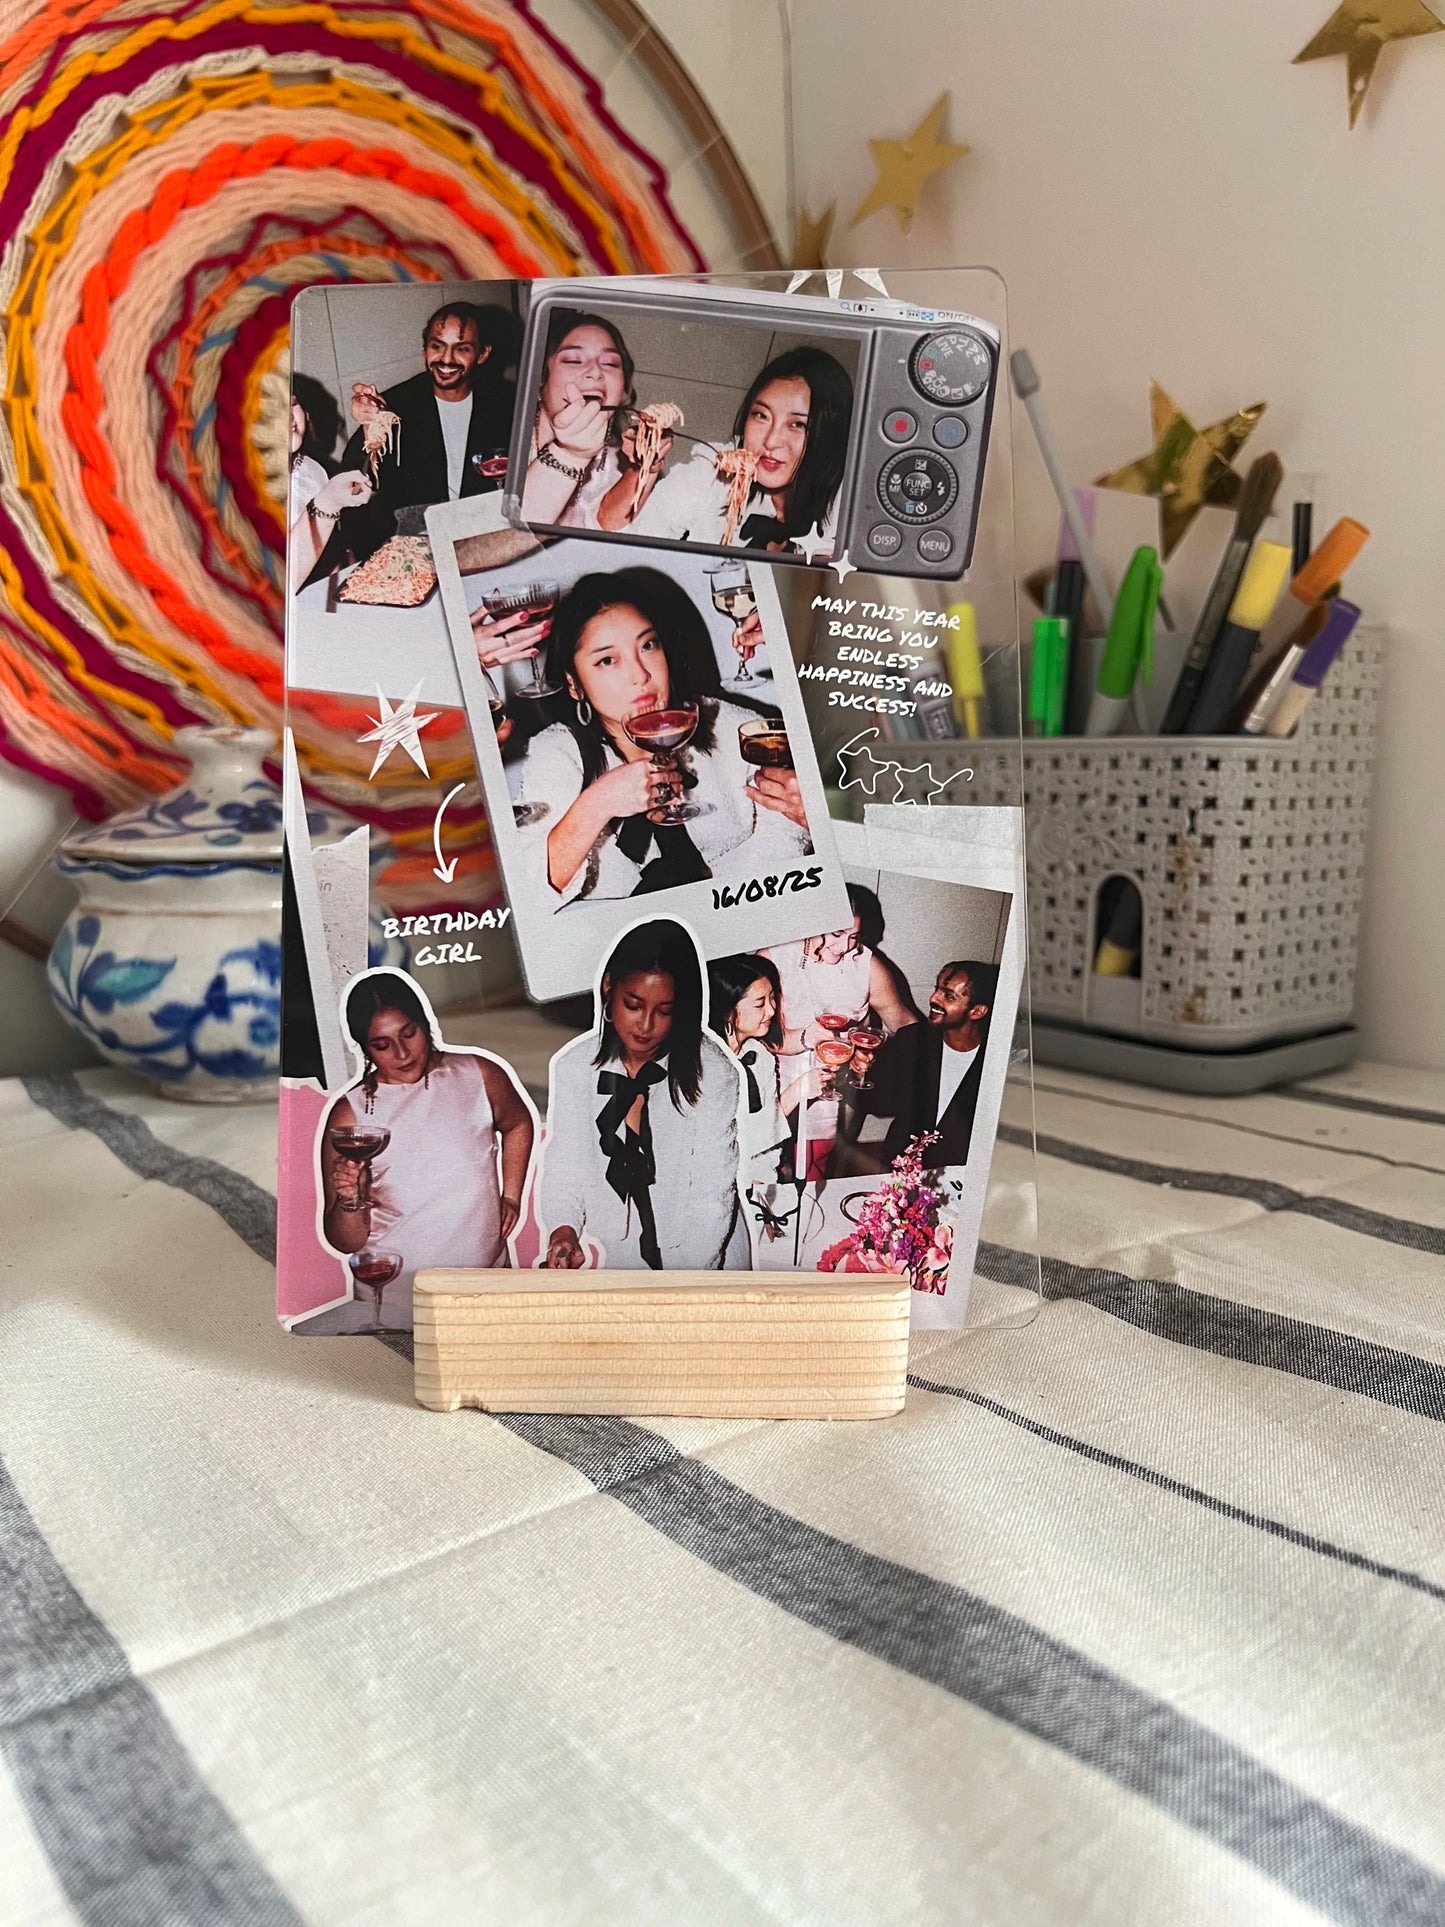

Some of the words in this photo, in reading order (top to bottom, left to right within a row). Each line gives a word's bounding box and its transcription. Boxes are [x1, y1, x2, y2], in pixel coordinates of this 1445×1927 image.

[936, 337, 954, 358] LIVE
[909, 488, 925, 497] SET
[919, 540, 950, 553] MENU
[811, 595, 857, 614] MAY
[861, 602, 909, 621] THIS
[913, 609, 961, 631] YEAR
[828, 621, 894, 643] BRING
[899, 630, 938, 649] YOU
[836, 646, 924, 671] ENDLESS
[797, 663, 911, 693] HAPPINESS
[913, 680, 953, 698] AND
[828, 691, 917, 718] SUCCESS!
[712, 866, 824, 910] 16/08/25
[380, 907, 512, 939] BIRTHDAY
[414, 942, 482, 966] GIRL
